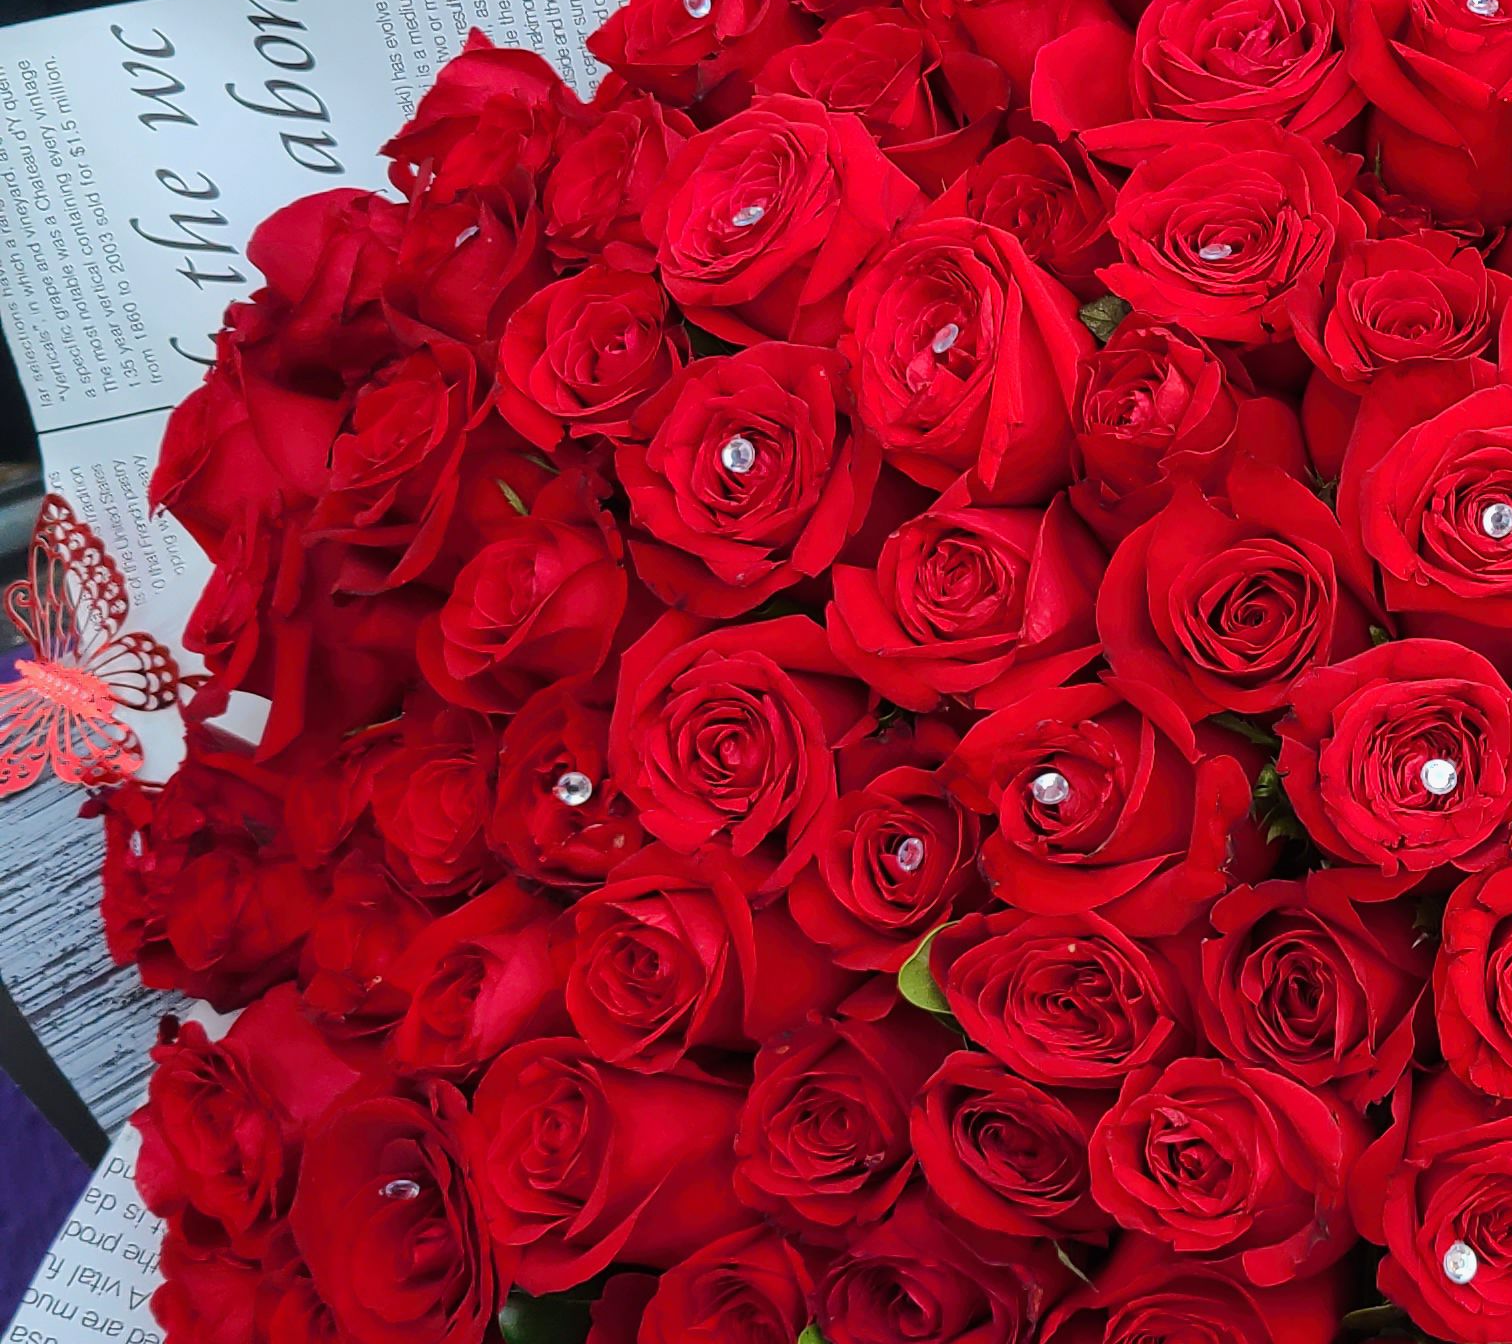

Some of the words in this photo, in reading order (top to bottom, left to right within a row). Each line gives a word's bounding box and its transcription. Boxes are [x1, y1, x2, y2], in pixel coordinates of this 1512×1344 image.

[374, 0, 399, 49] evolve
[43, 54, 72, 114] million.
[387, 51, 407, 82] has
[16, 58, 48, 121] vintage
[38, 124, 63, 168] every
[59, 118, 86, 158] $1.5
[18, 144, 51, 212] Chateau
[76, 162, 96, 187] for
[54, 171, 94, 257] containing
[83, 191, 109, 227] sold
[48, 228, 70, 261] was
[128, 167, 247, 291] the
[25, 241, 49, 272] and
[96, 230, 126, 274] 2003
[8, 251, 35, 297] which
[60, 262, 92, 321] notable
[81, 260, 116, 318] vertical
[116, 279, 132, 296] to
[40, 273, 70, 321] grape
[107, 321, 134, 355] year
[121, 301, 148, 340] 1860
[81, 324, 108, 363] most
[98, 365, 119, 393] The
[120, 1242, 161, 1275] the
[65, 1263, 121, 1297] vital
[128, 1284, 153, 1311] A
[80, 1309, 125, 1337] are
